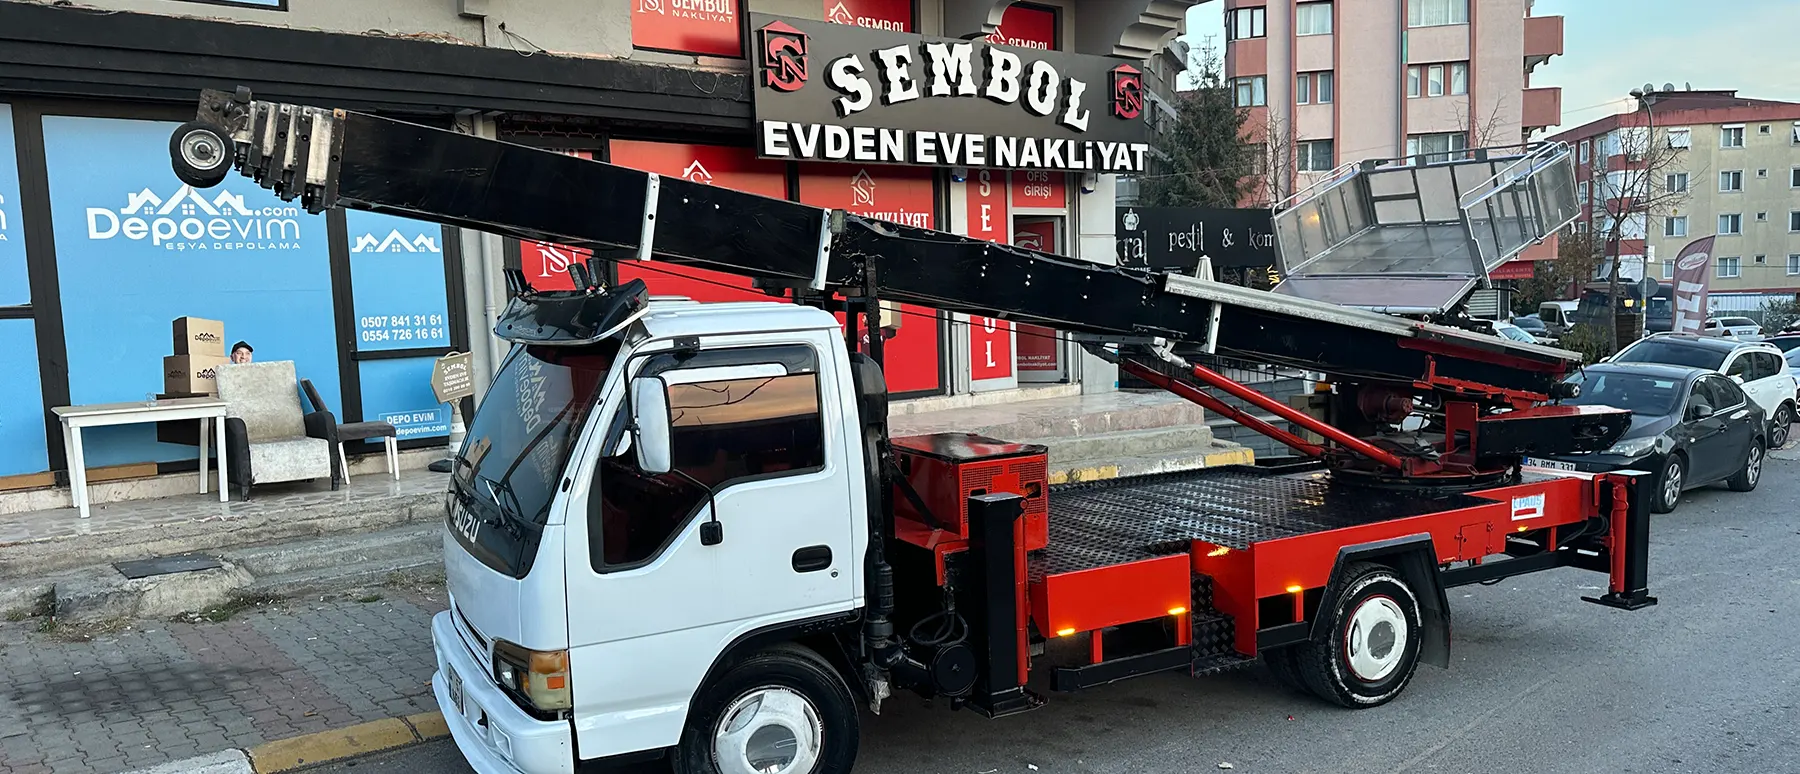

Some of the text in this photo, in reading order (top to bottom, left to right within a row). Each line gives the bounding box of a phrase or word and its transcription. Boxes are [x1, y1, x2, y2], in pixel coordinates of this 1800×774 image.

[829, 42, 1090, 132] SEMBOL
[762, 120, 904, 162] EVDEN
[916, 131, 985, 165] EVE
[1024, 183, 1052, 199] GİRİŞİ
[86, 207, 300, 246] Depoevim
[1169, 221, 1204, 252] pestil
[1222, 227, 1235, 248] &
[165, 242, 301, 252] EŞYA DEPOLAMA
[361, 314, 442, 328] 0507 841 31 61
[362, 327, 443, 342] 0554 726 16 61
[386, 414, 411, 424] DEPO
[396, 425, 447, 436] depoevim.com
